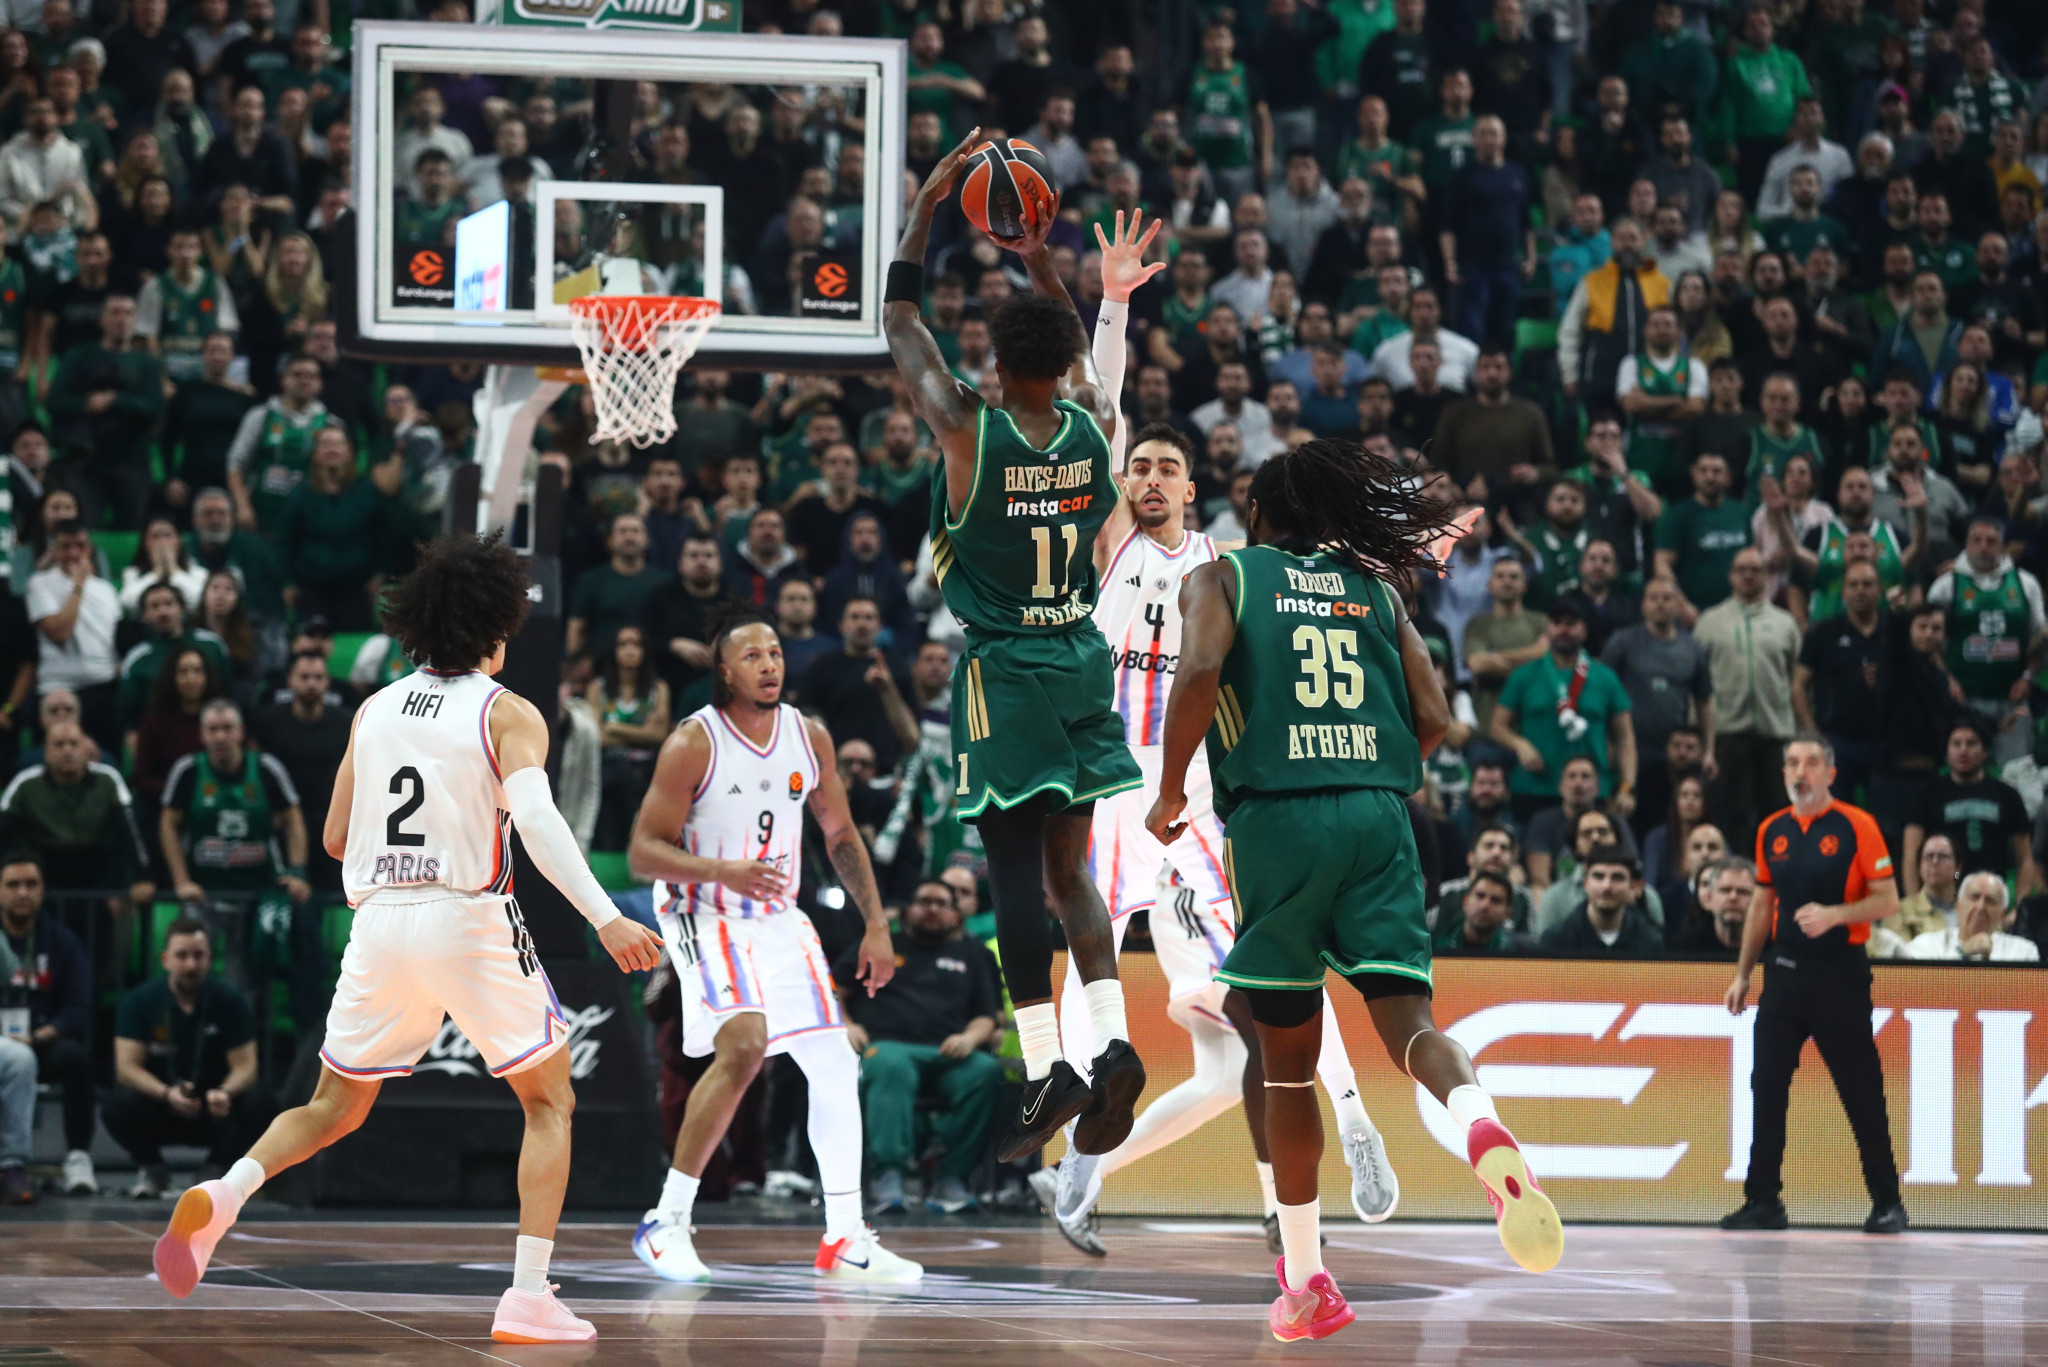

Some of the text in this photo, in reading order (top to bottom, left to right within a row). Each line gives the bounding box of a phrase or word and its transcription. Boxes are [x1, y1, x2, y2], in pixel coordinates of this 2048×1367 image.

[1004, 458, 1093, 493] HAYES-DAVIS
[1006, 494, 1093, 517] instacar
[1031, 523, 1078, 598] 11
[1144, 602, 1165, 642] 4
[1275, 593, 1371, 618] instacar
[1292, 624, 1365, 709] 35
[401, 690, 445, 719] HIFI
[1288, 724, 1378, 762] ATHENS
[956, 753, 970, 795] 1
[386, 765, 426, 847] 2
[758, 810, 774, 845] 9
[371, 853, 441, 885] PARIS
